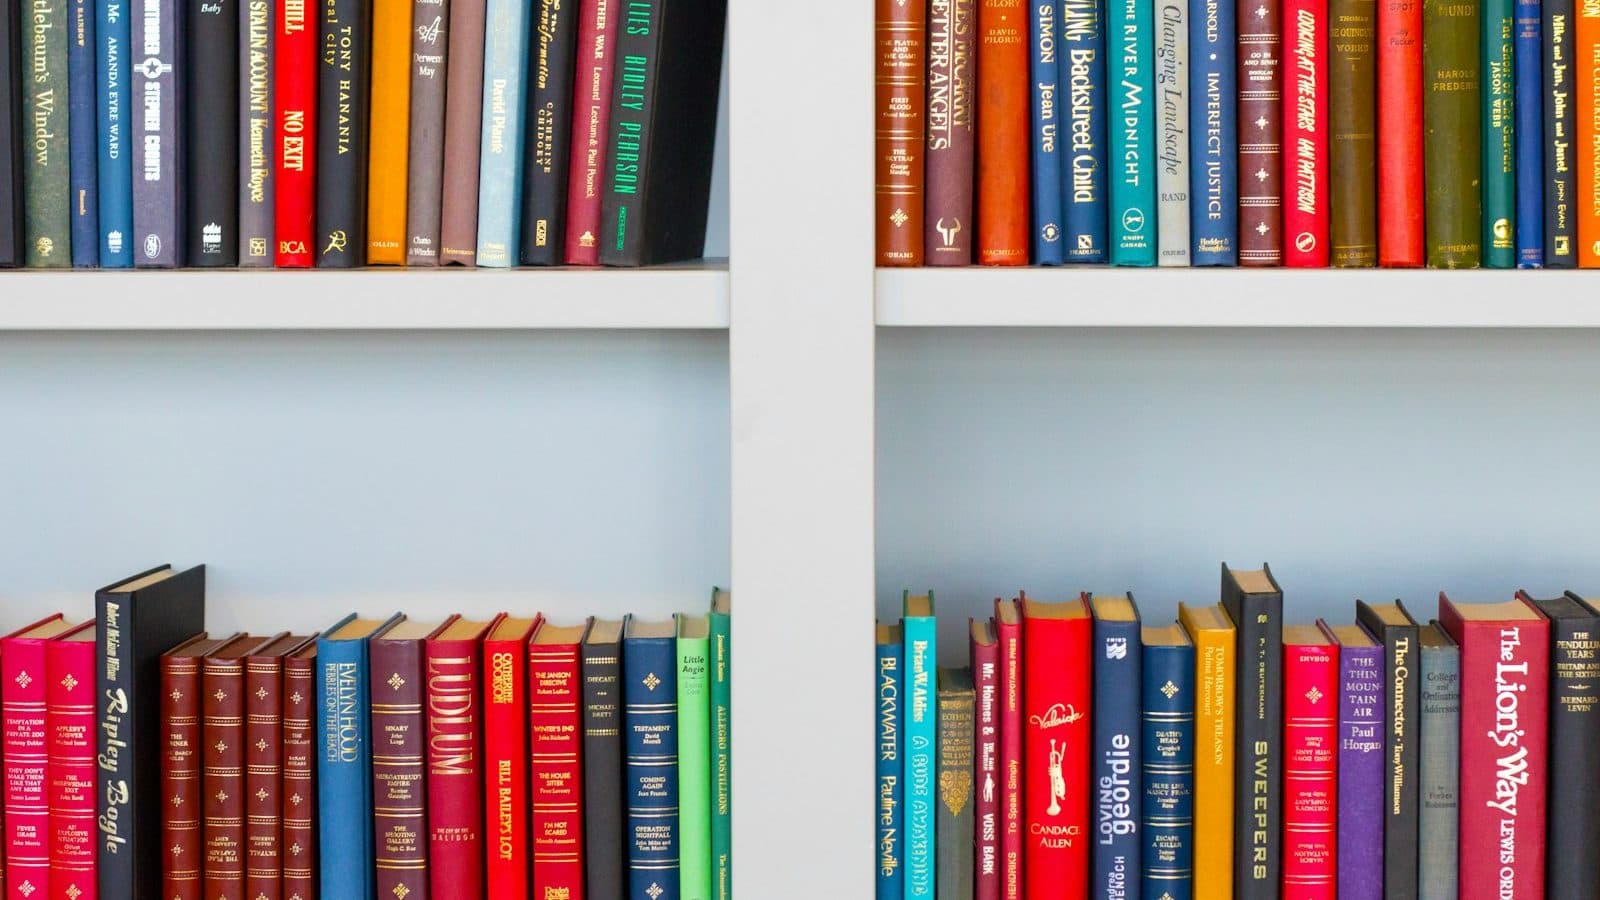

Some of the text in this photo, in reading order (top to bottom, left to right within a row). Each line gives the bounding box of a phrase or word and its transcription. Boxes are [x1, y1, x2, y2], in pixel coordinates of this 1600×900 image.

[201, 4, 222, 14] Baby
[285, 0, 304, 35] HILL
[627, 1, 652, 36] LIES
[1039, 5, 1054, 63] SIMON
[1552, 14, 1566, 44] Mike
[325, 34, 338, 65] city
[419, 67, 435, 79] May
[594, 35, 605, 59] WAR
[33, 0, 53, 166] tlebaum's Window
[107, 4, 118, 159] Me AMANDA EYRE WARD
[248, 1, 268, 202] STALIN ACCOUNT Kenneth Royce
[338, 26, 352, 154] TONY HANANIA
[492, 79, 506, 114] David
[593, 66, 602, 101] Leonard
[621, 55, 647, 111] RIDLEY
[1038, 83, 1055, 120] Jean
[1121, 0, 1143, 186] THE RIVER MIDNIGHT
[1158, 4, 1184, 176] Changing Landscape
[1490, 60, 1502, 128] JASON WEBB
[1553, 90, 1568, 118] John
[544, 102, 553, 173] CATHERINE
[929, 73, 949, 150] ANGELS
[1070, 49, 1097, 204] Backstreet Child
[1294, 9, 1316, 215] LOOKING AT THE STARS IAN PATTISON
[284, 110, 304, 171] NO EXIT
[588, 149, 598, 167] Paul
[613, 122, 641, 195] PEARSON
[1206, 73, 1221, 220] IMPERFECT JUSTICE
[1554, 140, 1568, 173] Janet
[1161, 193, 1186, 202] RAND
[280, 242, 305, 253] BCA
[106, 602, 120, 629] Robert
[492, 652, 503, 705] COOKSON
[502, 652, 513, 704] CATHERINE
[682, 664, 705, 675] Angie
[683, 656, 704, 664] Little
[1204, 646, 1214, 716] Palma Harcourt
[1349, 671, 1377, 679] THIN
[1352, 658, 1374, 666] THE
[1567, 650, 1594, 658] YEARS
[326, 663, 338, 762] PEBBLES ON THE BEACH
[340, 662, 357, 763] EVELYN HOOD
[429, 656, 473, 775] LUDLUM
[983, 663, 994, 736] Mr. Holmes &
[1214, 646, 1224, 766] TOMORROW'S TREASON
[1346, 683, 1383, 692] MOUN-
[1349, 695, 1376, 704] TAIN
[1353, 708, 1372, 716] AIR
[911, 736, 929, 749] A
[1343, 740, 1382, 752] Horgan
[1352, 726, 1374, 738] Paul
[1393, 636, 1408, 815] The Connector Tony Williamson
[1486, 627, 1528, 864] The Lion's Way LEWIS
[98, 688, 129, 854] Ripley Bogle
[718, 705, 727, 816] ALLEGRO POSTILLIONS
[880, 657, 898, 877] BLACKWATER Pauline Neville
[911, 754, 929, 796] RUDE
[1110, 734, 1136, 836] geordie
[499, 759, 511, 860] BILL BAILEY'S LOT
[1008, 759, 1018, 900] HENDRIKS To Speak Simply
[1030, 823, 1081, 834] CANDACE
[1100, 776, 1113, 845] LOVING
[1253, 741, 1268, 879] SWEEPERS
[910, 800, 929, 900] AWAKENING
[983, 813, 995, 875] VOSS BARK
[1040, 836, 1072, 848] ALLEN
